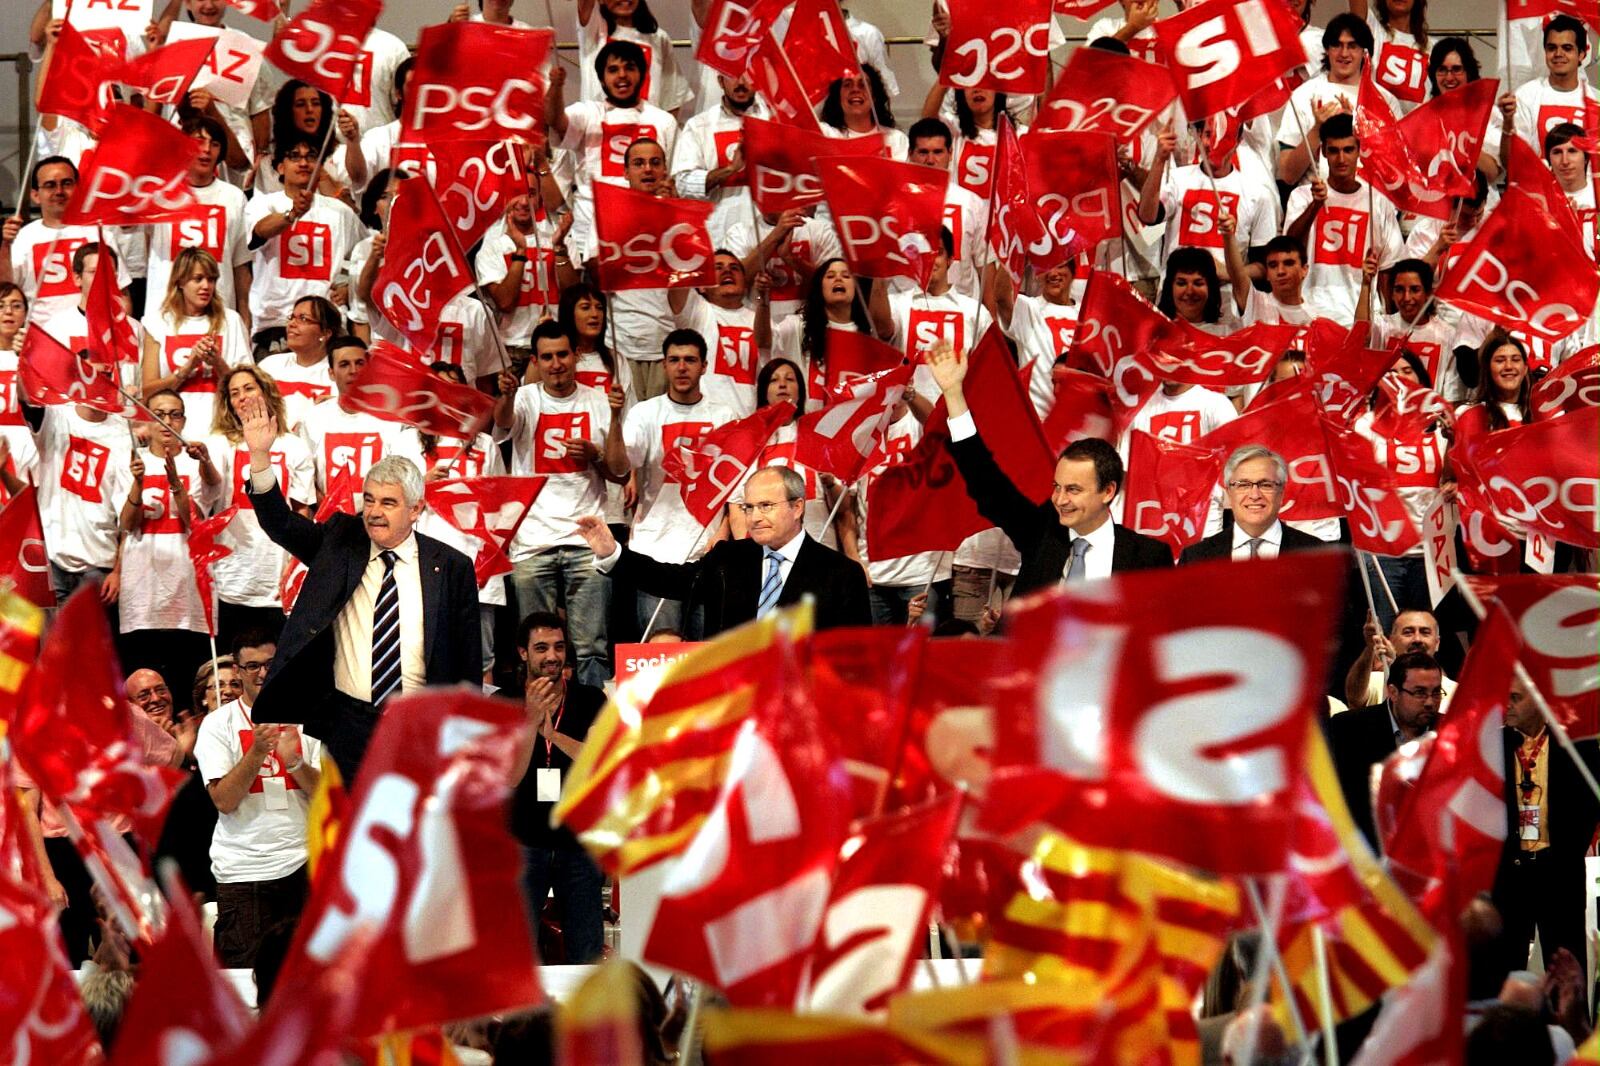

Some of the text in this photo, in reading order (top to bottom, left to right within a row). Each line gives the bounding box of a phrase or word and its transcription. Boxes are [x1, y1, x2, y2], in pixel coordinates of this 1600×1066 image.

[412, 78, 537, 130] PSC
[81, 166, 195, 214] PSC
[1456, 250, 1580, 336] PSC
[1430, 505, 1451, 588] PAZ
